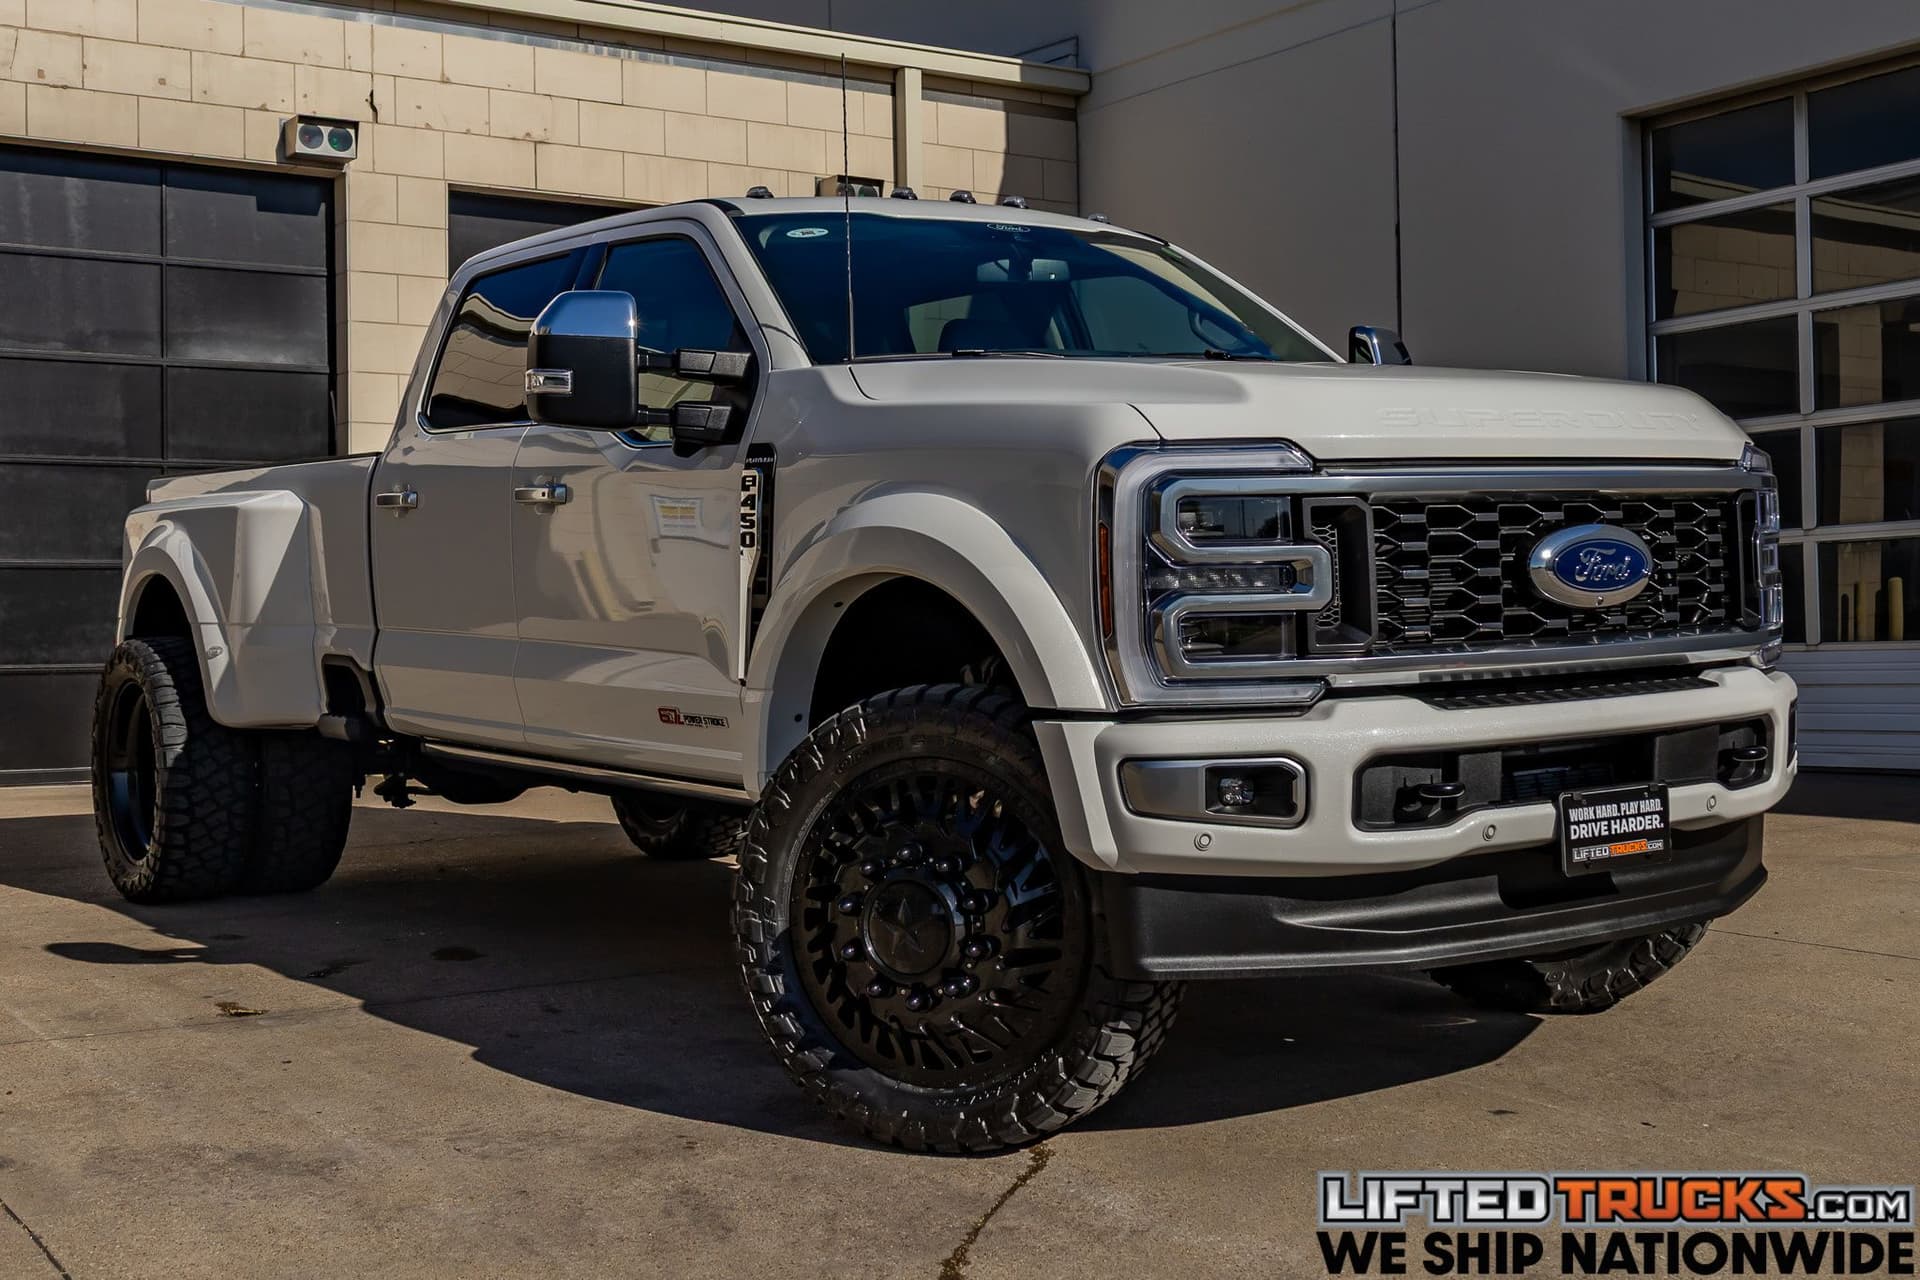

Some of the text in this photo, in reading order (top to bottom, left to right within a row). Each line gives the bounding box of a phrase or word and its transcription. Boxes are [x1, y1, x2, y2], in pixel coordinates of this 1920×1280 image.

[1575, 547, 1631, 582] Ford
[1569, 798, 1663, 822] WORK HARD. PLAY HARD.
[1570, 814, 1664, 840] DRIVE HARDER.
